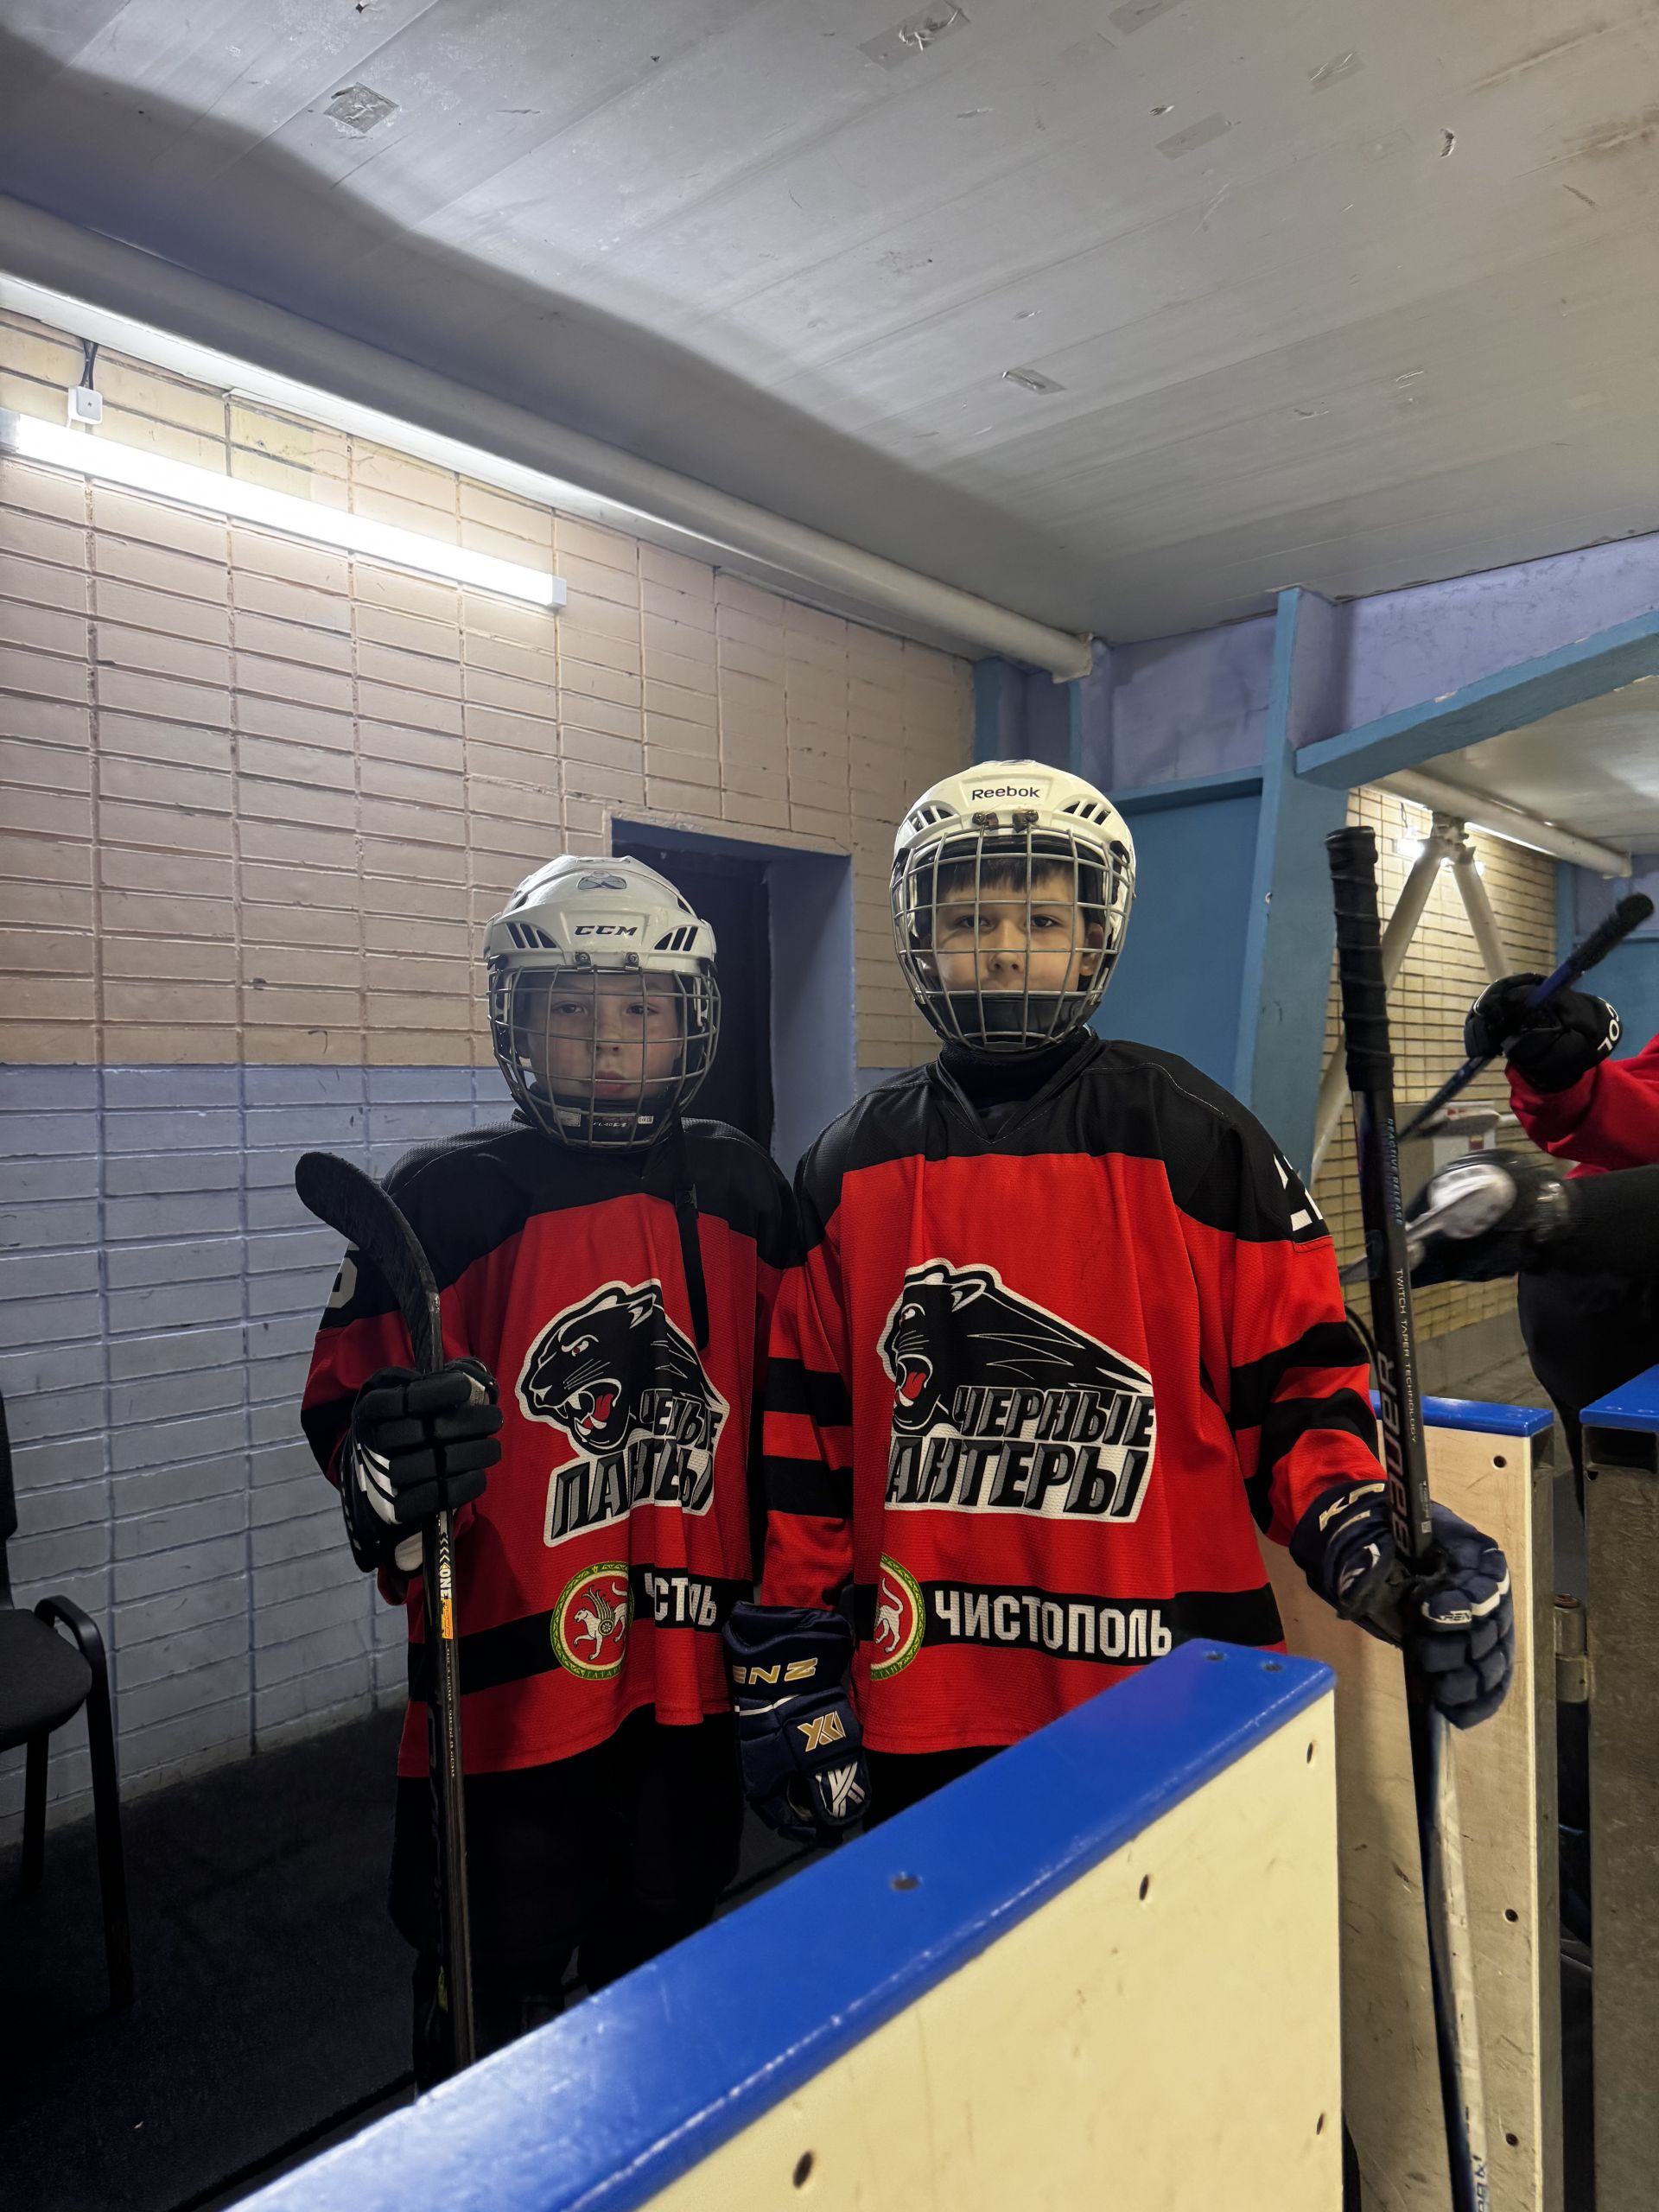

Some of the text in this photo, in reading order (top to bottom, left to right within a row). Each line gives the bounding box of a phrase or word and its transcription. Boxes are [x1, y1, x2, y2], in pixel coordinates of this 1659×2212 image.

[971, 785, 1040, 800] Reebok
[575, 925, 638, 936] CCM
[1395, 1268, 1417, 1443] TWITCH TAPER TECHNOLOGY
[953, 1387, 1155, 1446] ЧЕРНЫЕ
[885, 1436, 1149, 1517] АНТЕРЫ
[439, 1568, 452, 1599] ONE
[934, 1590, 1173, 1657] ЧИСТОПОЛЬ
[733, 1657, 818, 1685] ENZ
